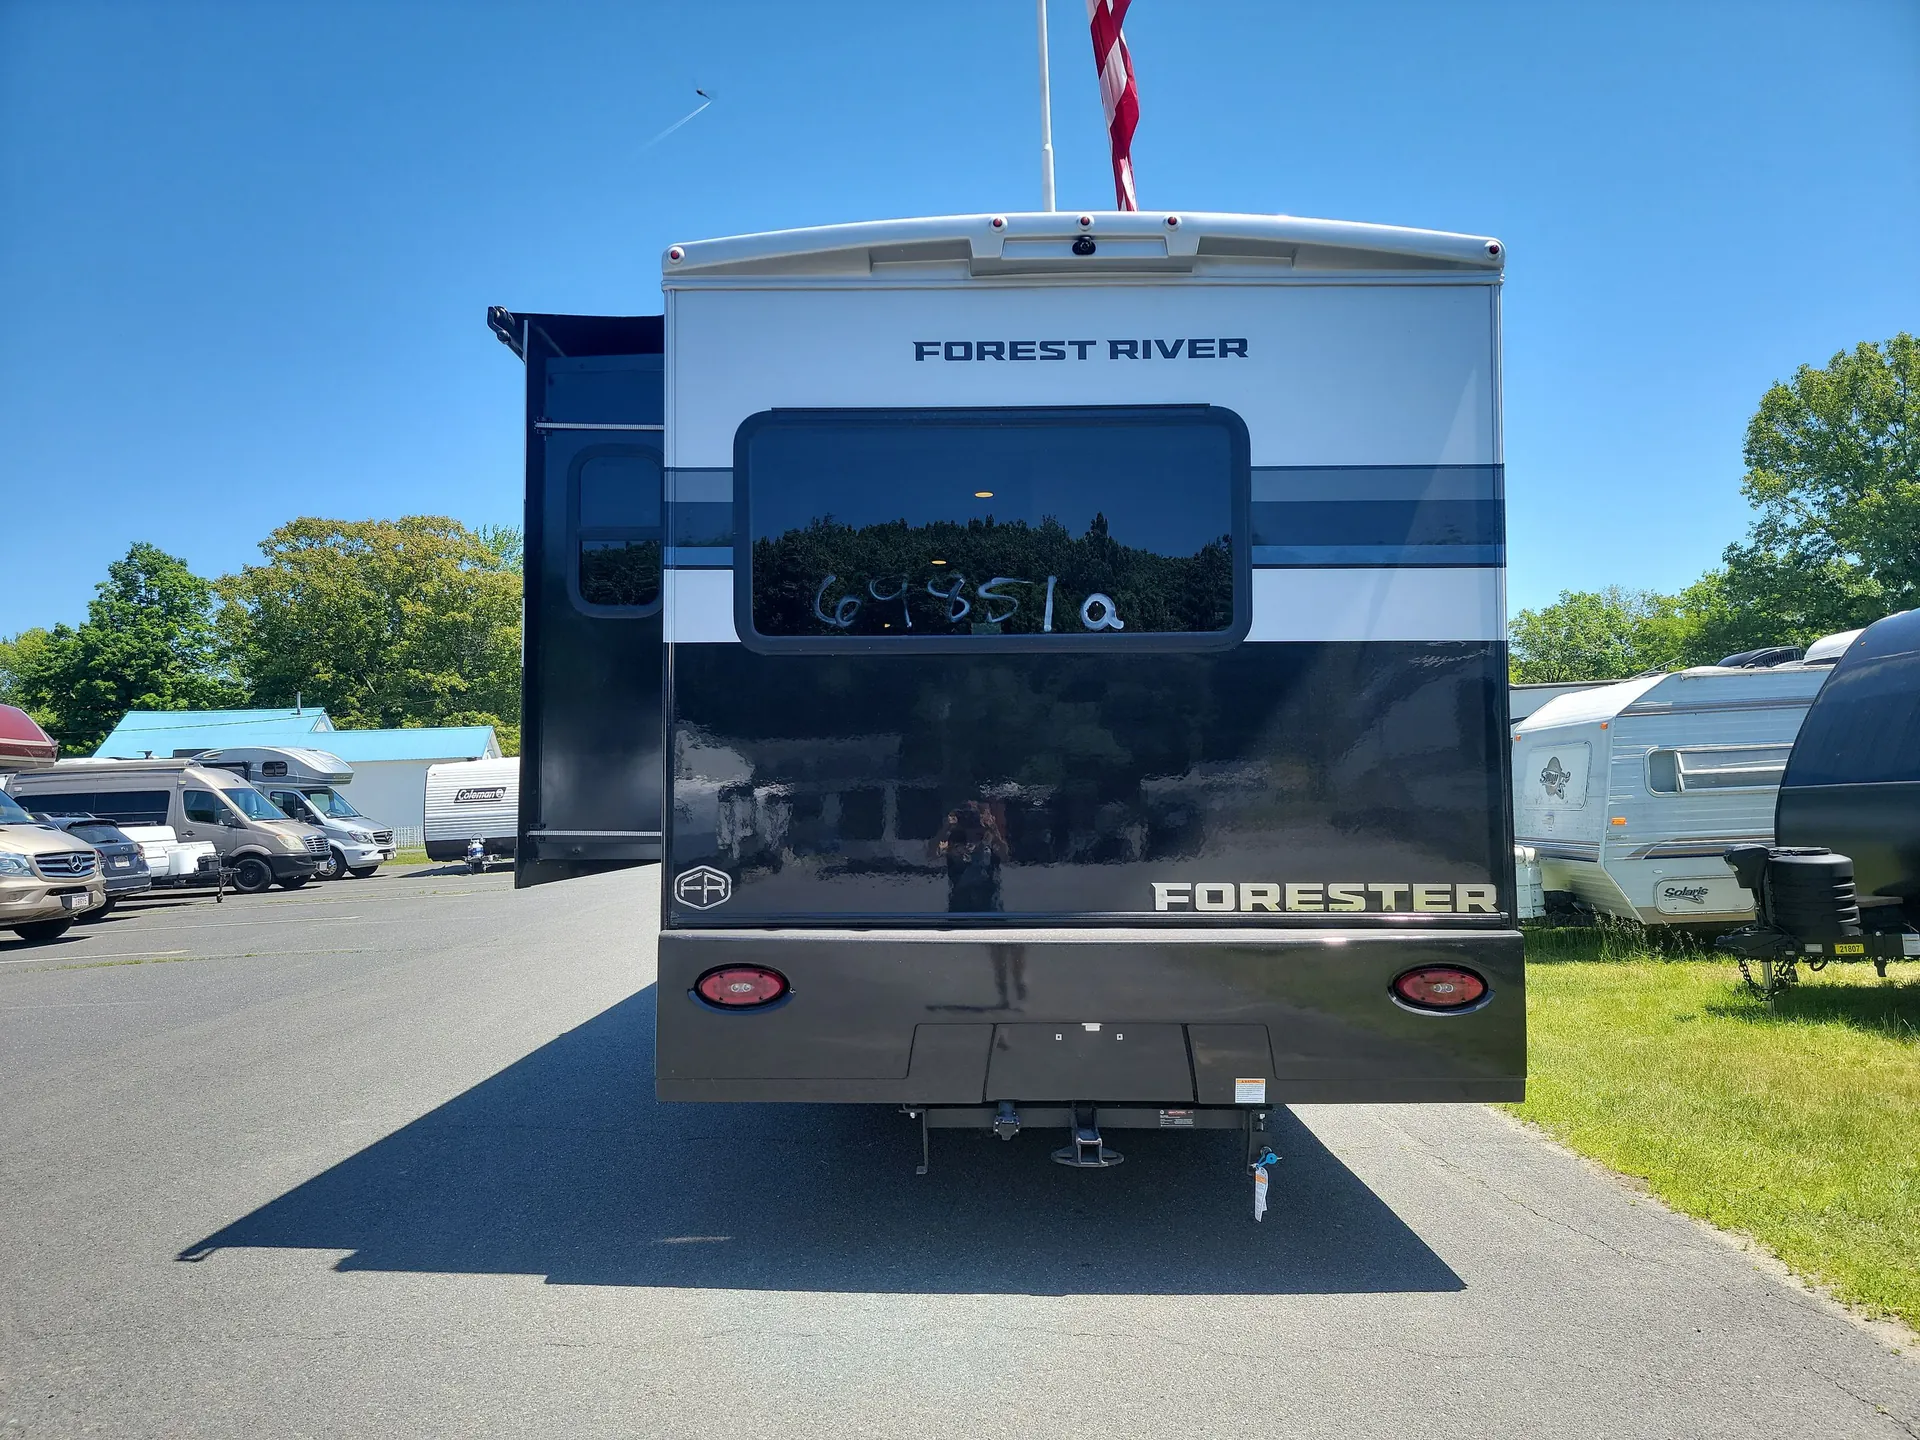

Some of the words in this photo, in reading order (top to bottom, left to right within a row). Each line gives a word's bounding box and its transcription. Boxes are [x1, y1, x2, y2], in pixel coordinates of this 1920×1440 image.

[912, 340, 1097, 361] FOREST
[1106, 338, 1249, 360] RIVER
[458, 789, 496, 800] Coleman
[1151, 882, 1500, 913] FORESTER
[1663, 886, 1709, 898] Solaris
[1840, 945, 1860, 953] 21807
